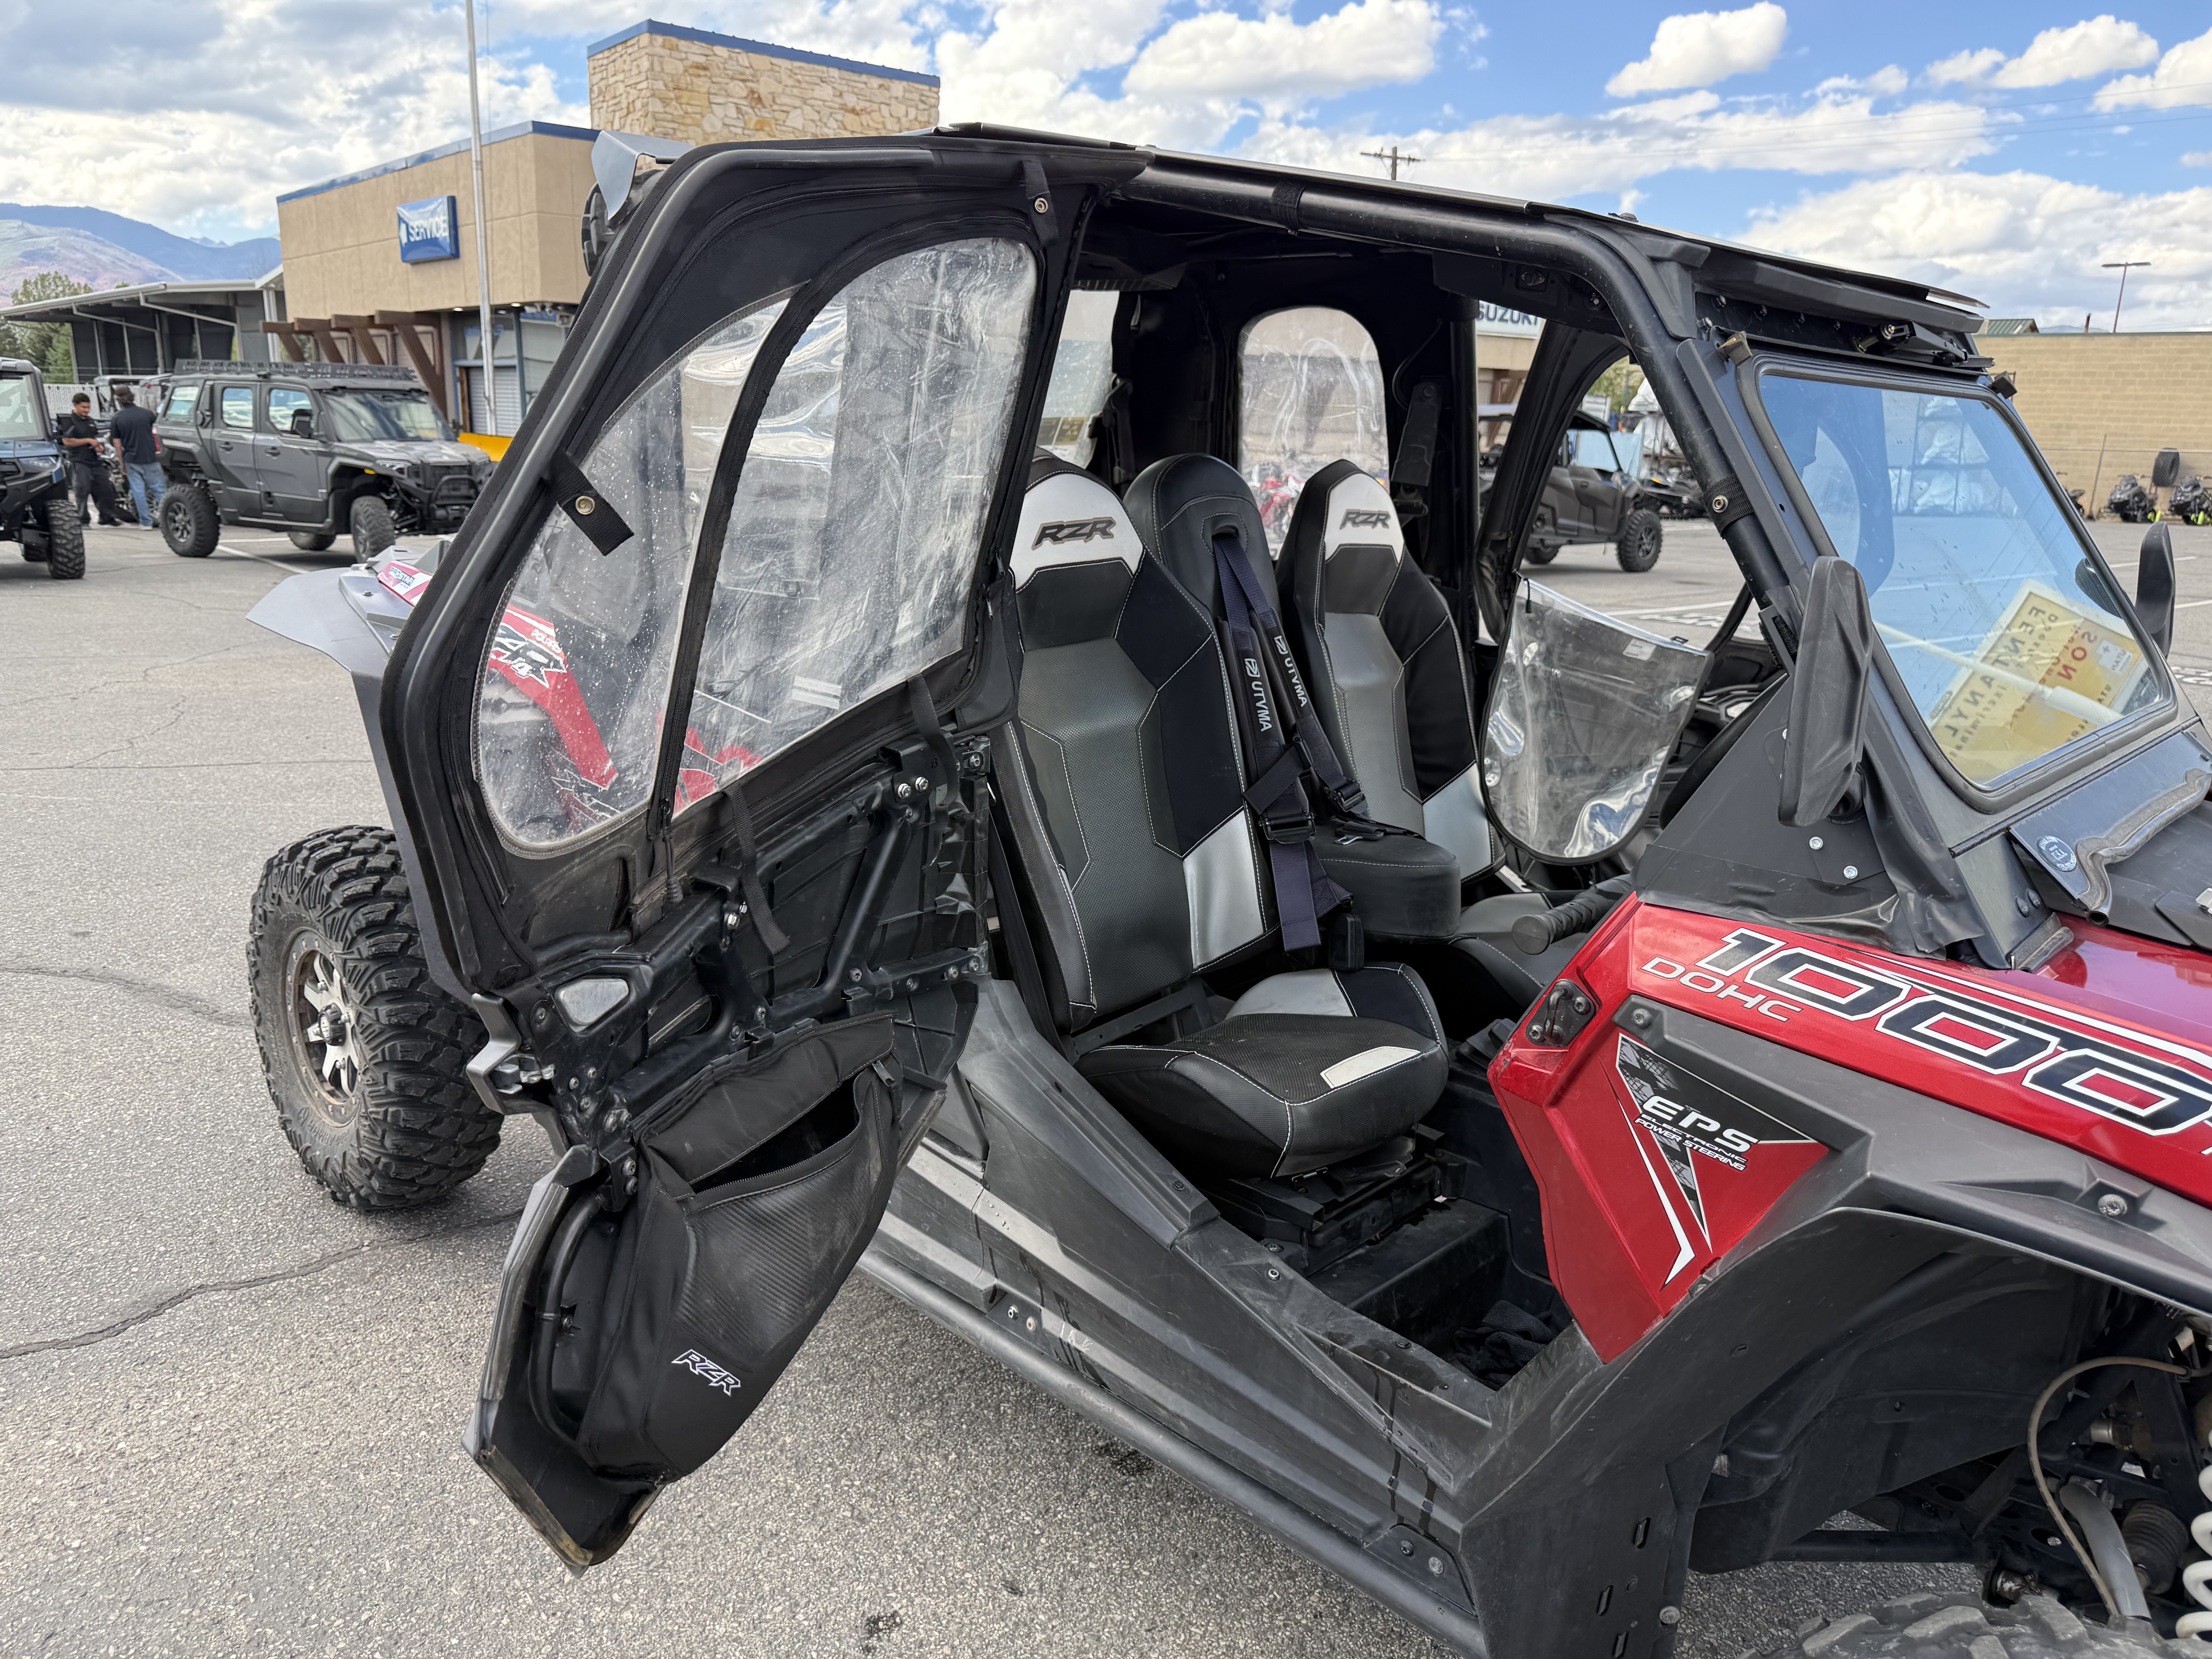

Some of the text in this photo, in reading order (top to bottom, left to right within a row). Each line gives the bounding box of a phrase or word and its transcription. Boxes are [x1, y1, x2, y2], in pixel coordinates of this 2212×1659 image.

[409, 215, 449, 242] SERVICE
[1031, 517, 1116, 551] RZR
[1340, 509, 1391, 530] RZR
[1252, 681, 1272, 732] UTVMA
[1285, 658, 1307, 707] UTVMA
[1641, 956, 1804, 1022] DOHC
[1695, 927, 2212, 1136] 1000
[1635, 1118, 1746, 1171] POWER STEERING
[1641, 1114, 1747, 1163] ELECTRONIC
[1643, 1096, 1758, 1152] EPS
[671, 1349, 741, 1396] RZR
